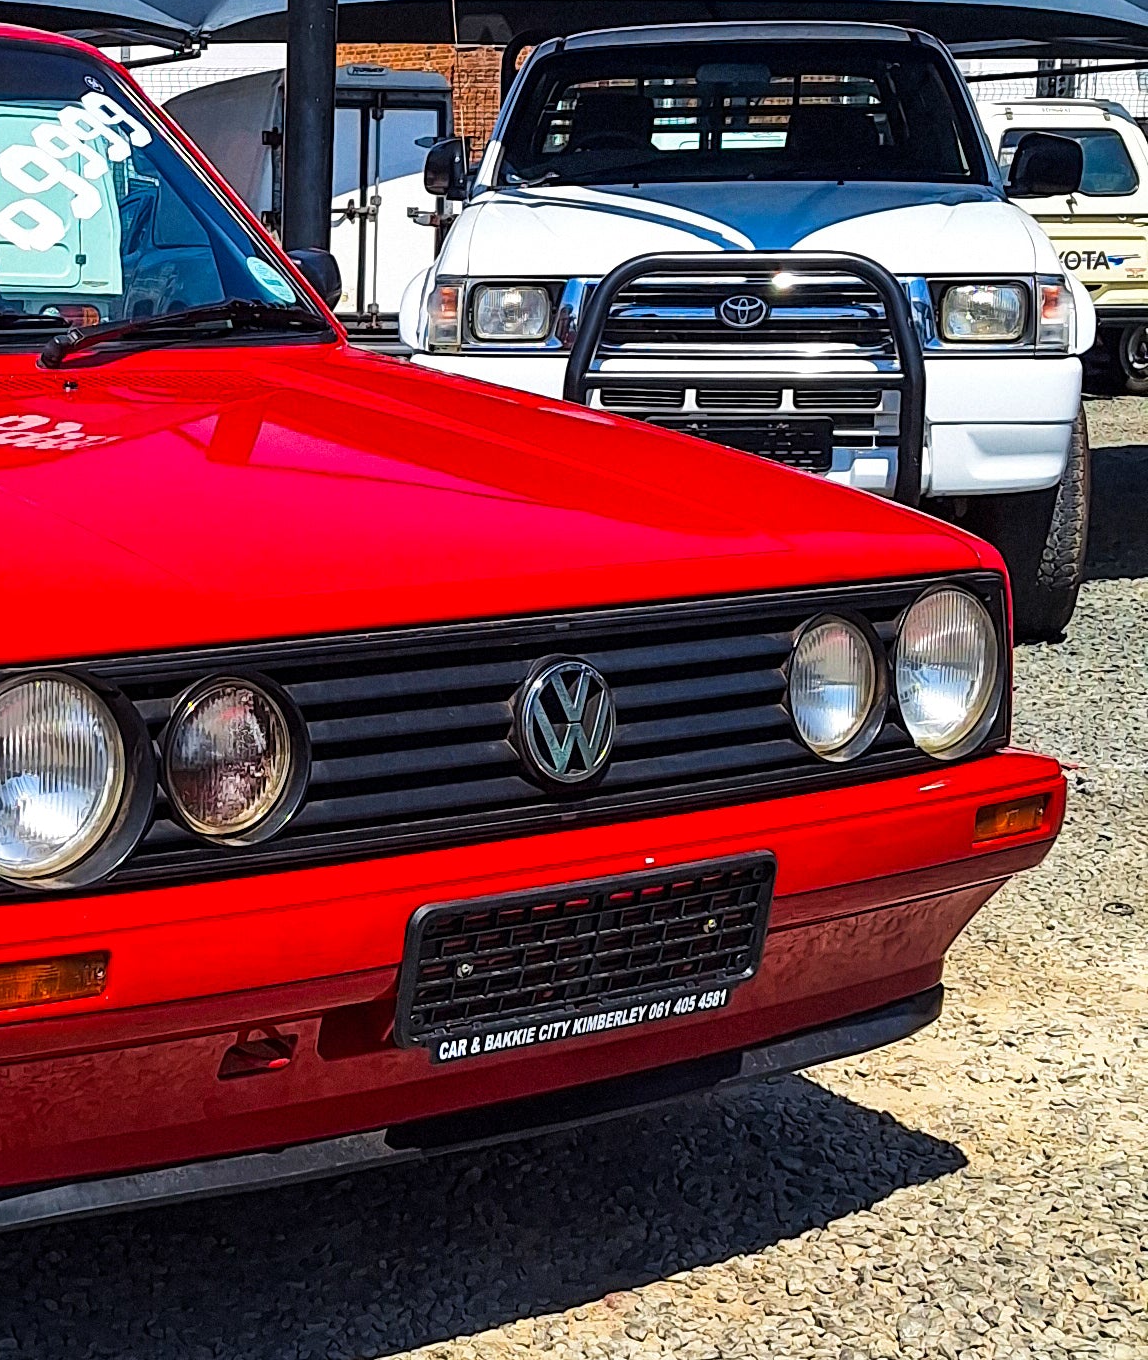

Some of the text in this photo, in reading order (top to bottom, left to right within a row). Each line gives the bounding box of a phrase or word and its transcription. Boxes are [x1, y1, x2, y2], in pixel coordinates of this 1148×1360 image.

[439, 989, 727, 1060] CAR & BAKKIE CITY KIMBERLEY 061 405 4581
